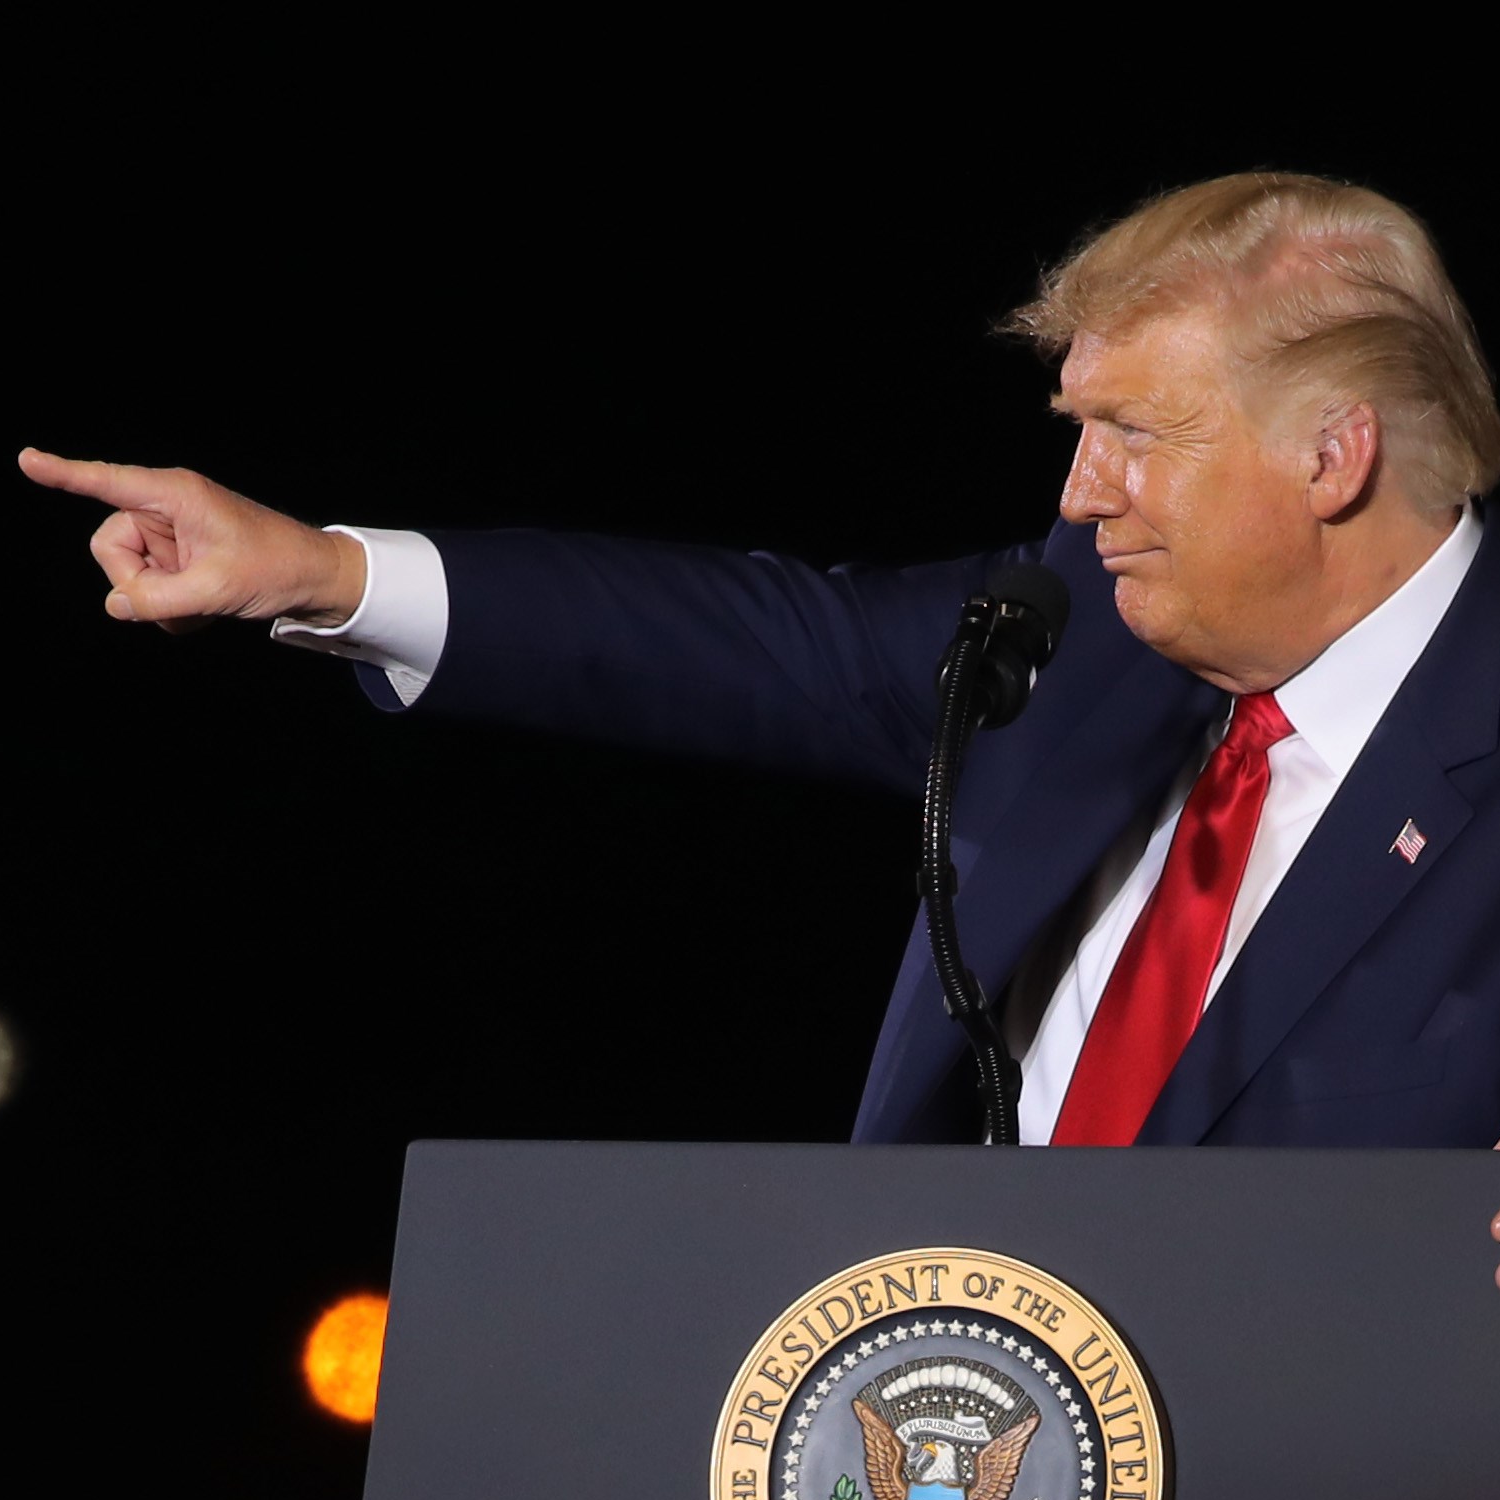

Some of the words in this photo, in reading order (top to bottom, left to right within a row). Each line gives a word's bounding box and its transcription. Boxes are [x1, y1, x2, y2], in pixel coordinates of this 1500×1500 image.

[731, 1264, 949, 1452] PRESIDENT
[962, 1271, 1005, 1300] OF
[1013, 1286, 1067, 1333] THE
